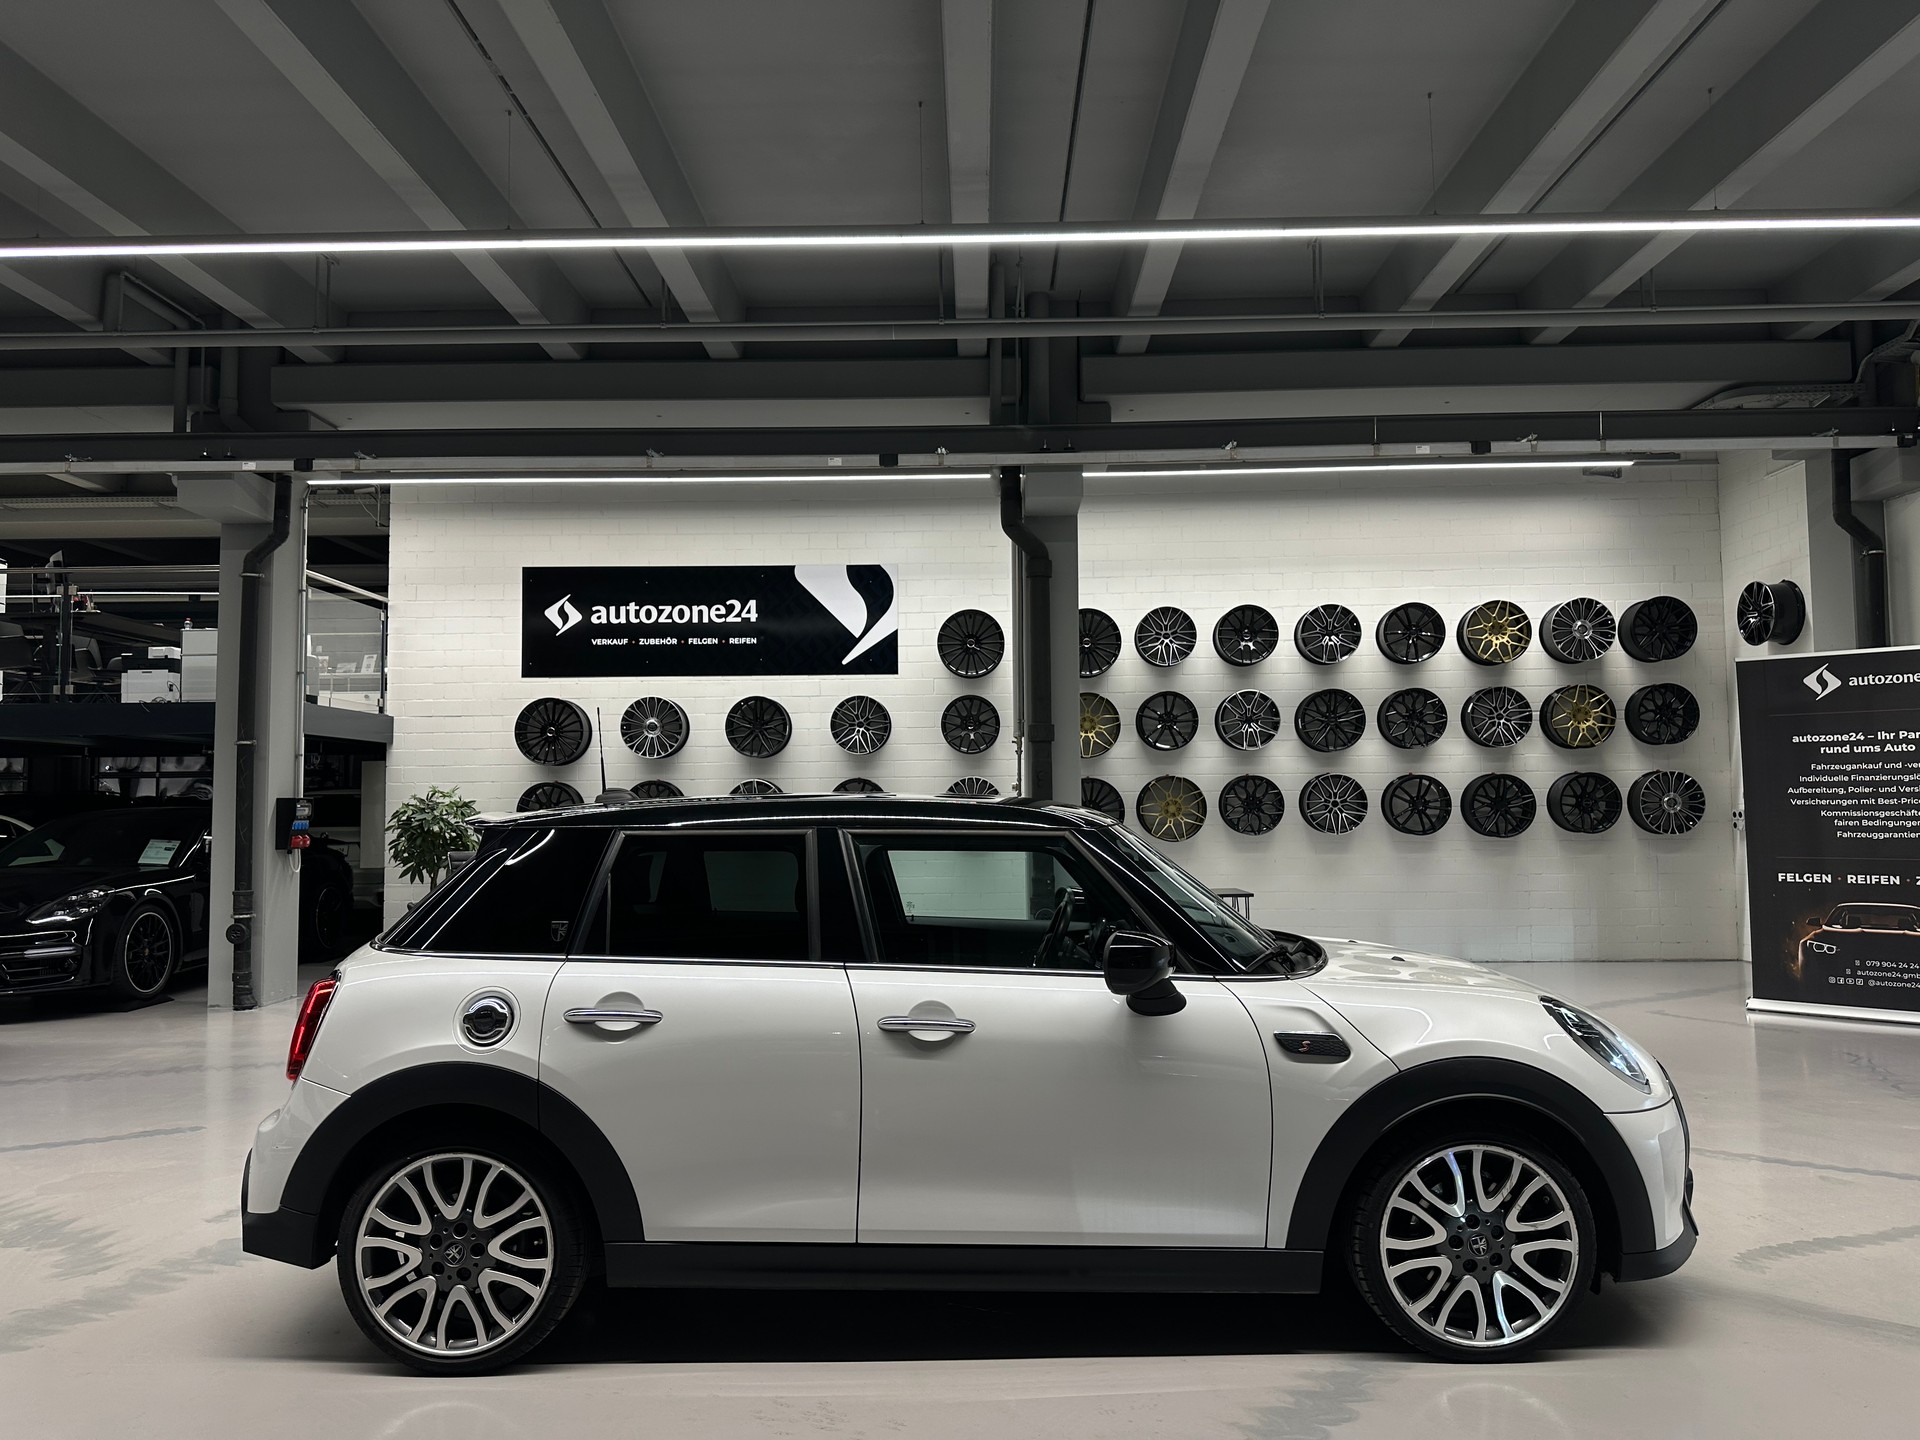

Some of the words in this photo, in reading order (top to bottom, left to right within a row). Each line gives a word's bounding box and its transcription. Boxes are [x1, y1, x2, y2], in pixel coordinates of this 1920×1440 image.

[590, 599, 758, 624] autozone24
[591, 638, 629, 646] VERKAUF
[638, 637, 678, 646] ZUBEHÖR
[688, 637, 718, 645] FELGEN
[729, 637, 757, 645] REIFEN
[1792, 732, 1865, 743] autozone24
[1877, 731, 1895, 740] Ihr
[1820, 744, 1850, 754] rund
[1853, 744, 1881, 753] ums
[1883, 743, 1916, 752] Auto
[1811, 762, 1882, 771] Fahrzeugankauf
[1799, 774, 1849, 782] Individuelle
[1787, 786, 1847, 795] Aufbereitung,
[1790, 798, 1859, 806] Versicherungen
[1877, 797, 1920, 805] Best-Pric
[1778, 873, 1832, 883] FELGEN
[1847, 874, 1900, 885] REIFEN
